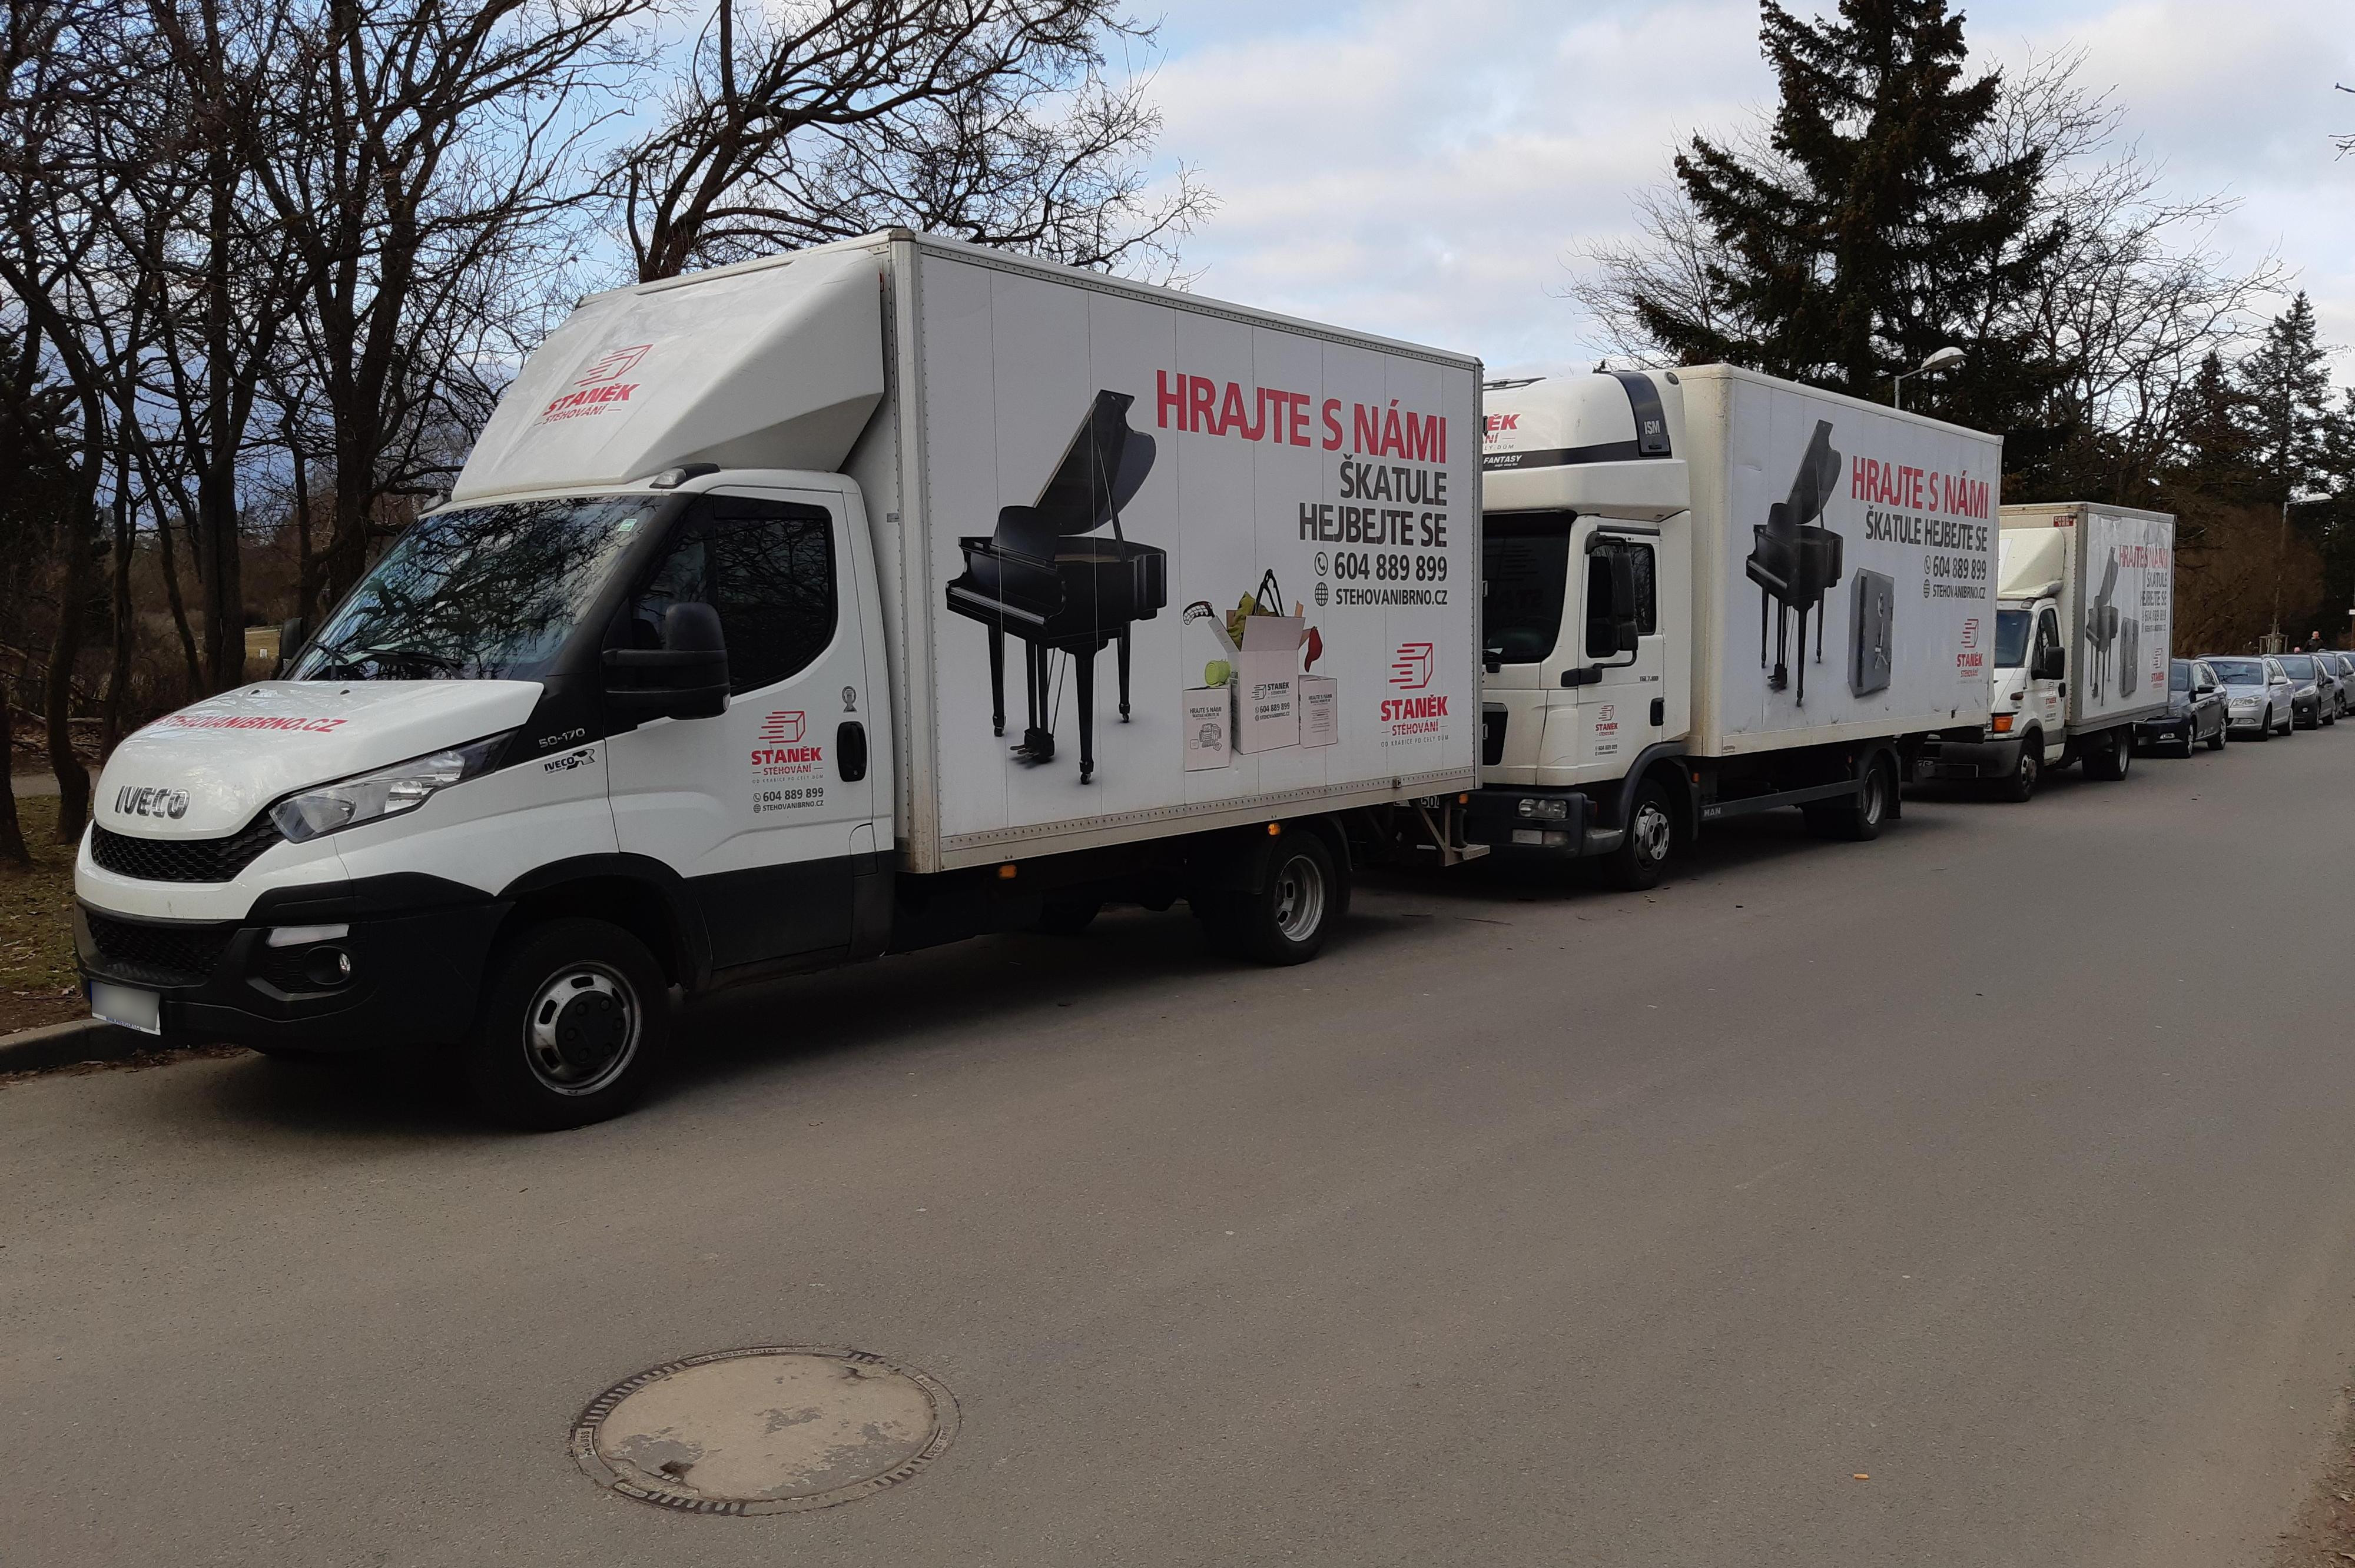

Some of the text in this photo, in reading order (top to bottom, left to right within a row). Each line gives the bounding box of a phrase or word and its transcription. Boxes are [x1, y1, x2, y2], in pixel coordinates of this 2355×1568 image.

[542, 383, 641, 416] STANĚK
[1156, 370, 1447, 464] HRAJTE S NÁMI
[1644, 420, 1660, 434] ISM
[1483, 455, 1523, 464] FANTASY
[1340, 454, 1447, 506] ŠKATULE
[1852, 456, 1989, 519] HRAJTE S NÁMI
[1299, 503, 1447, 547] HEJBEJTE SE
[1866, 504, 1988, 552] ŠKATULE HEJBEJTE SE
[1334, 552, 1448, 582] 604 889 899
[1933, 556, 1986, 580] 604 889 899
[1336, 588, 1448, 606] STEHOVANIBRNO.CZ
[1933, 584, 1986, 599] STEHOVANIBRNO.CZ
[1957, 651, 1983, 667] STANĚK
[1268, 682, 1289, 690] STANĚK
[1260, 705, 1269, 713] 604
[1381, 695, 1448, 722] STANĚK
[1392, 719, 1438, 736] STĚHOVÁNÍ
[1596, 722, 1618, 731] STANĚK
[539, 727, 585, 748] 50-170
[544, 756, 575, 772] IVECO
[751, 746, 822, 765] STANĚK
[764, 763, 812, 776] STĚHOVÁNÍ
[115, 785, 190, 819] IVECO
[763, 788, 823, 802] 604 889 899
[762, 800, 824, 812] STEHOVANIBRNO.CZ
[1704, 807, 1721, 817] MAN
